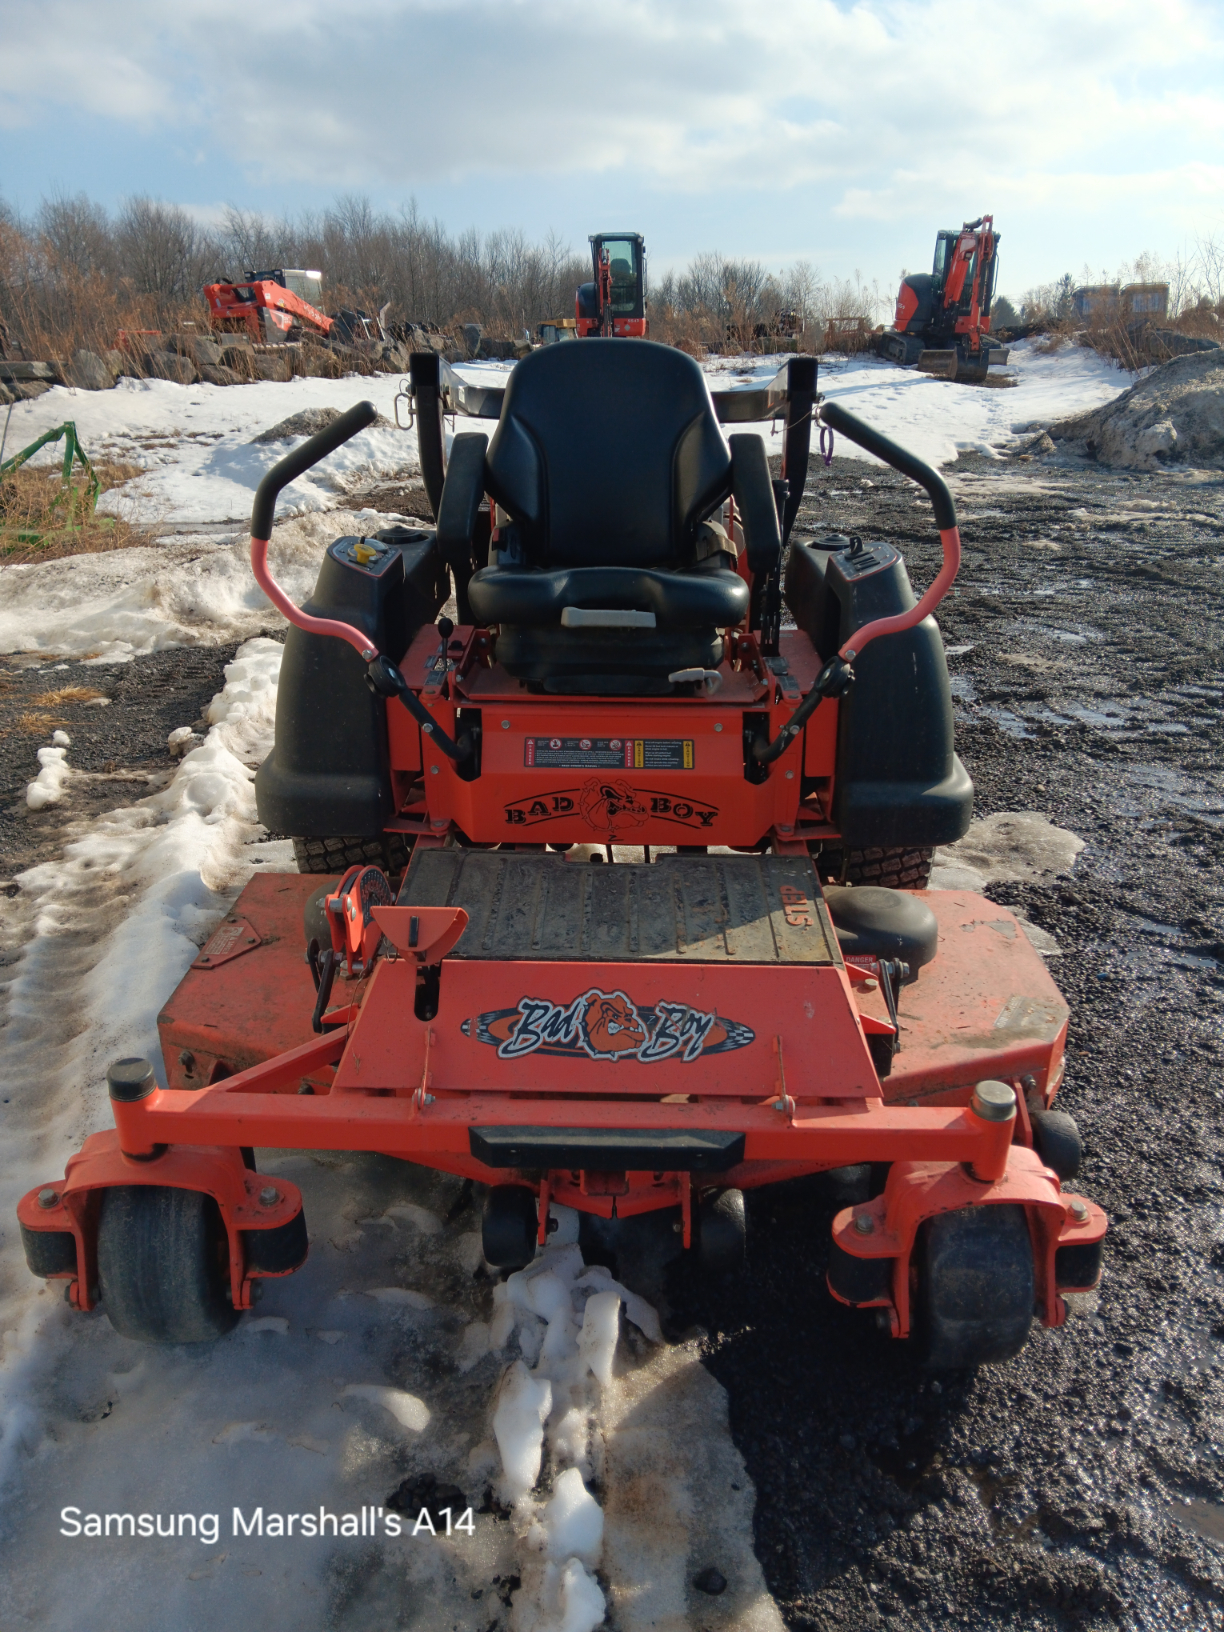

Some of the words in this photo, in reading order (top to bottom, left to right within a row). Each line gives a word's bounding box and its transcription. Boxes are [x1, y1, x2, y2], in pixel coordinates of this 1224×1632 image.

[505, 797, 574, 824] BAD
[650, 797, 719, 826] BOY
[780, 885, 814, 926] STEP
